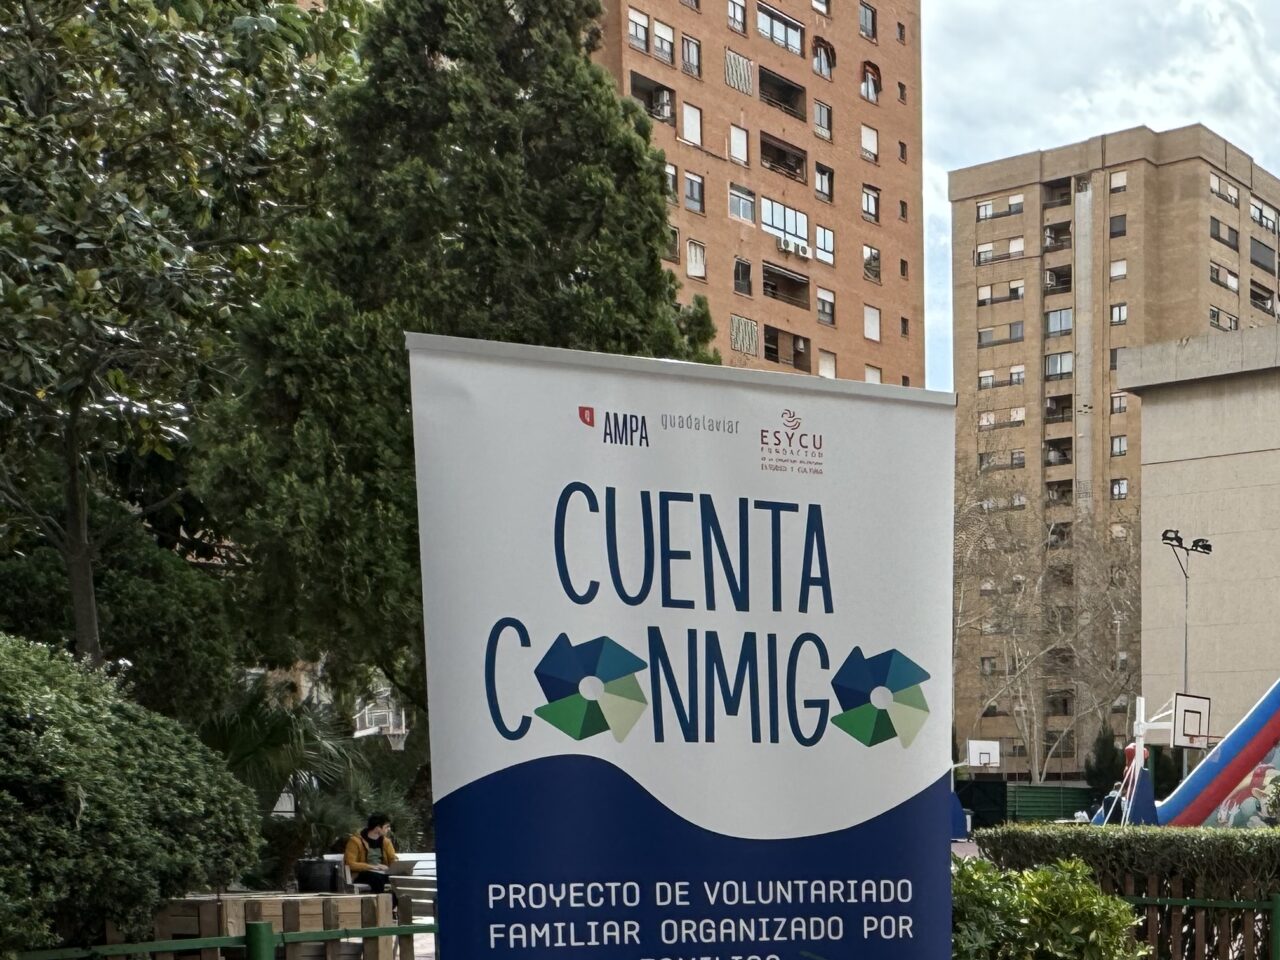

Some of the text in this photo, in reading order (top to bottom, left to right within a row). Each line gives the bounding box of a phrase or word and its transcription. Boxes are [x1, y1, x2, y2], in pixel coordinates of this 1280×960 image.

[603, 411, 649, 447] AMPA
[760, 429, 822, 450] ESYCU
[554, 481, 834, 613] CUENTA
[488, 878, 913, 909] PROYECTO DE VOLUNTARIADO
[489, 915, 914, 949] FAMILIAR ORGANIZADO POR
